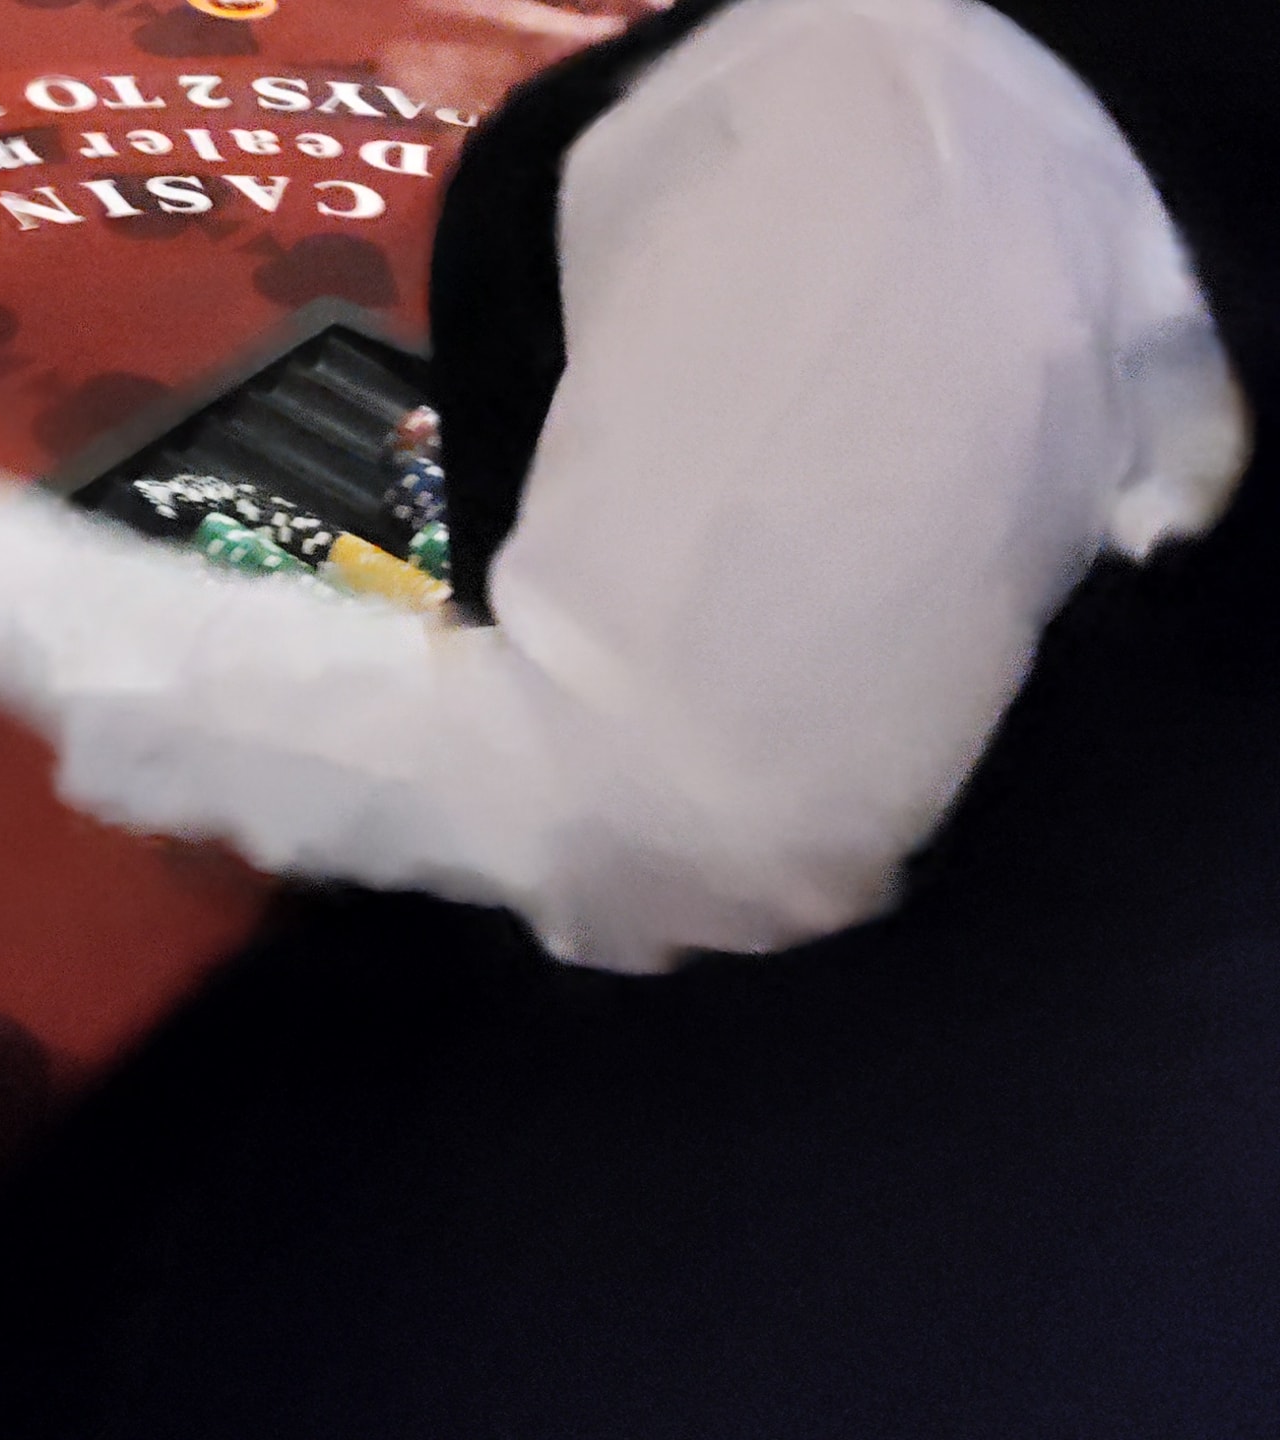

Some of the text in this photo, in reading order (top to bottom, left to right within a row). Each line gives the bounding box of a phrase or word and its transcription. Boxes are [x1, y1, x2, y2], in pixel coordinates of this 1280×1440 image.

[25, 74, 167, 113] TO
[178, 74, 233, 109] 2
[80, 129, 434, 177] Dealer
